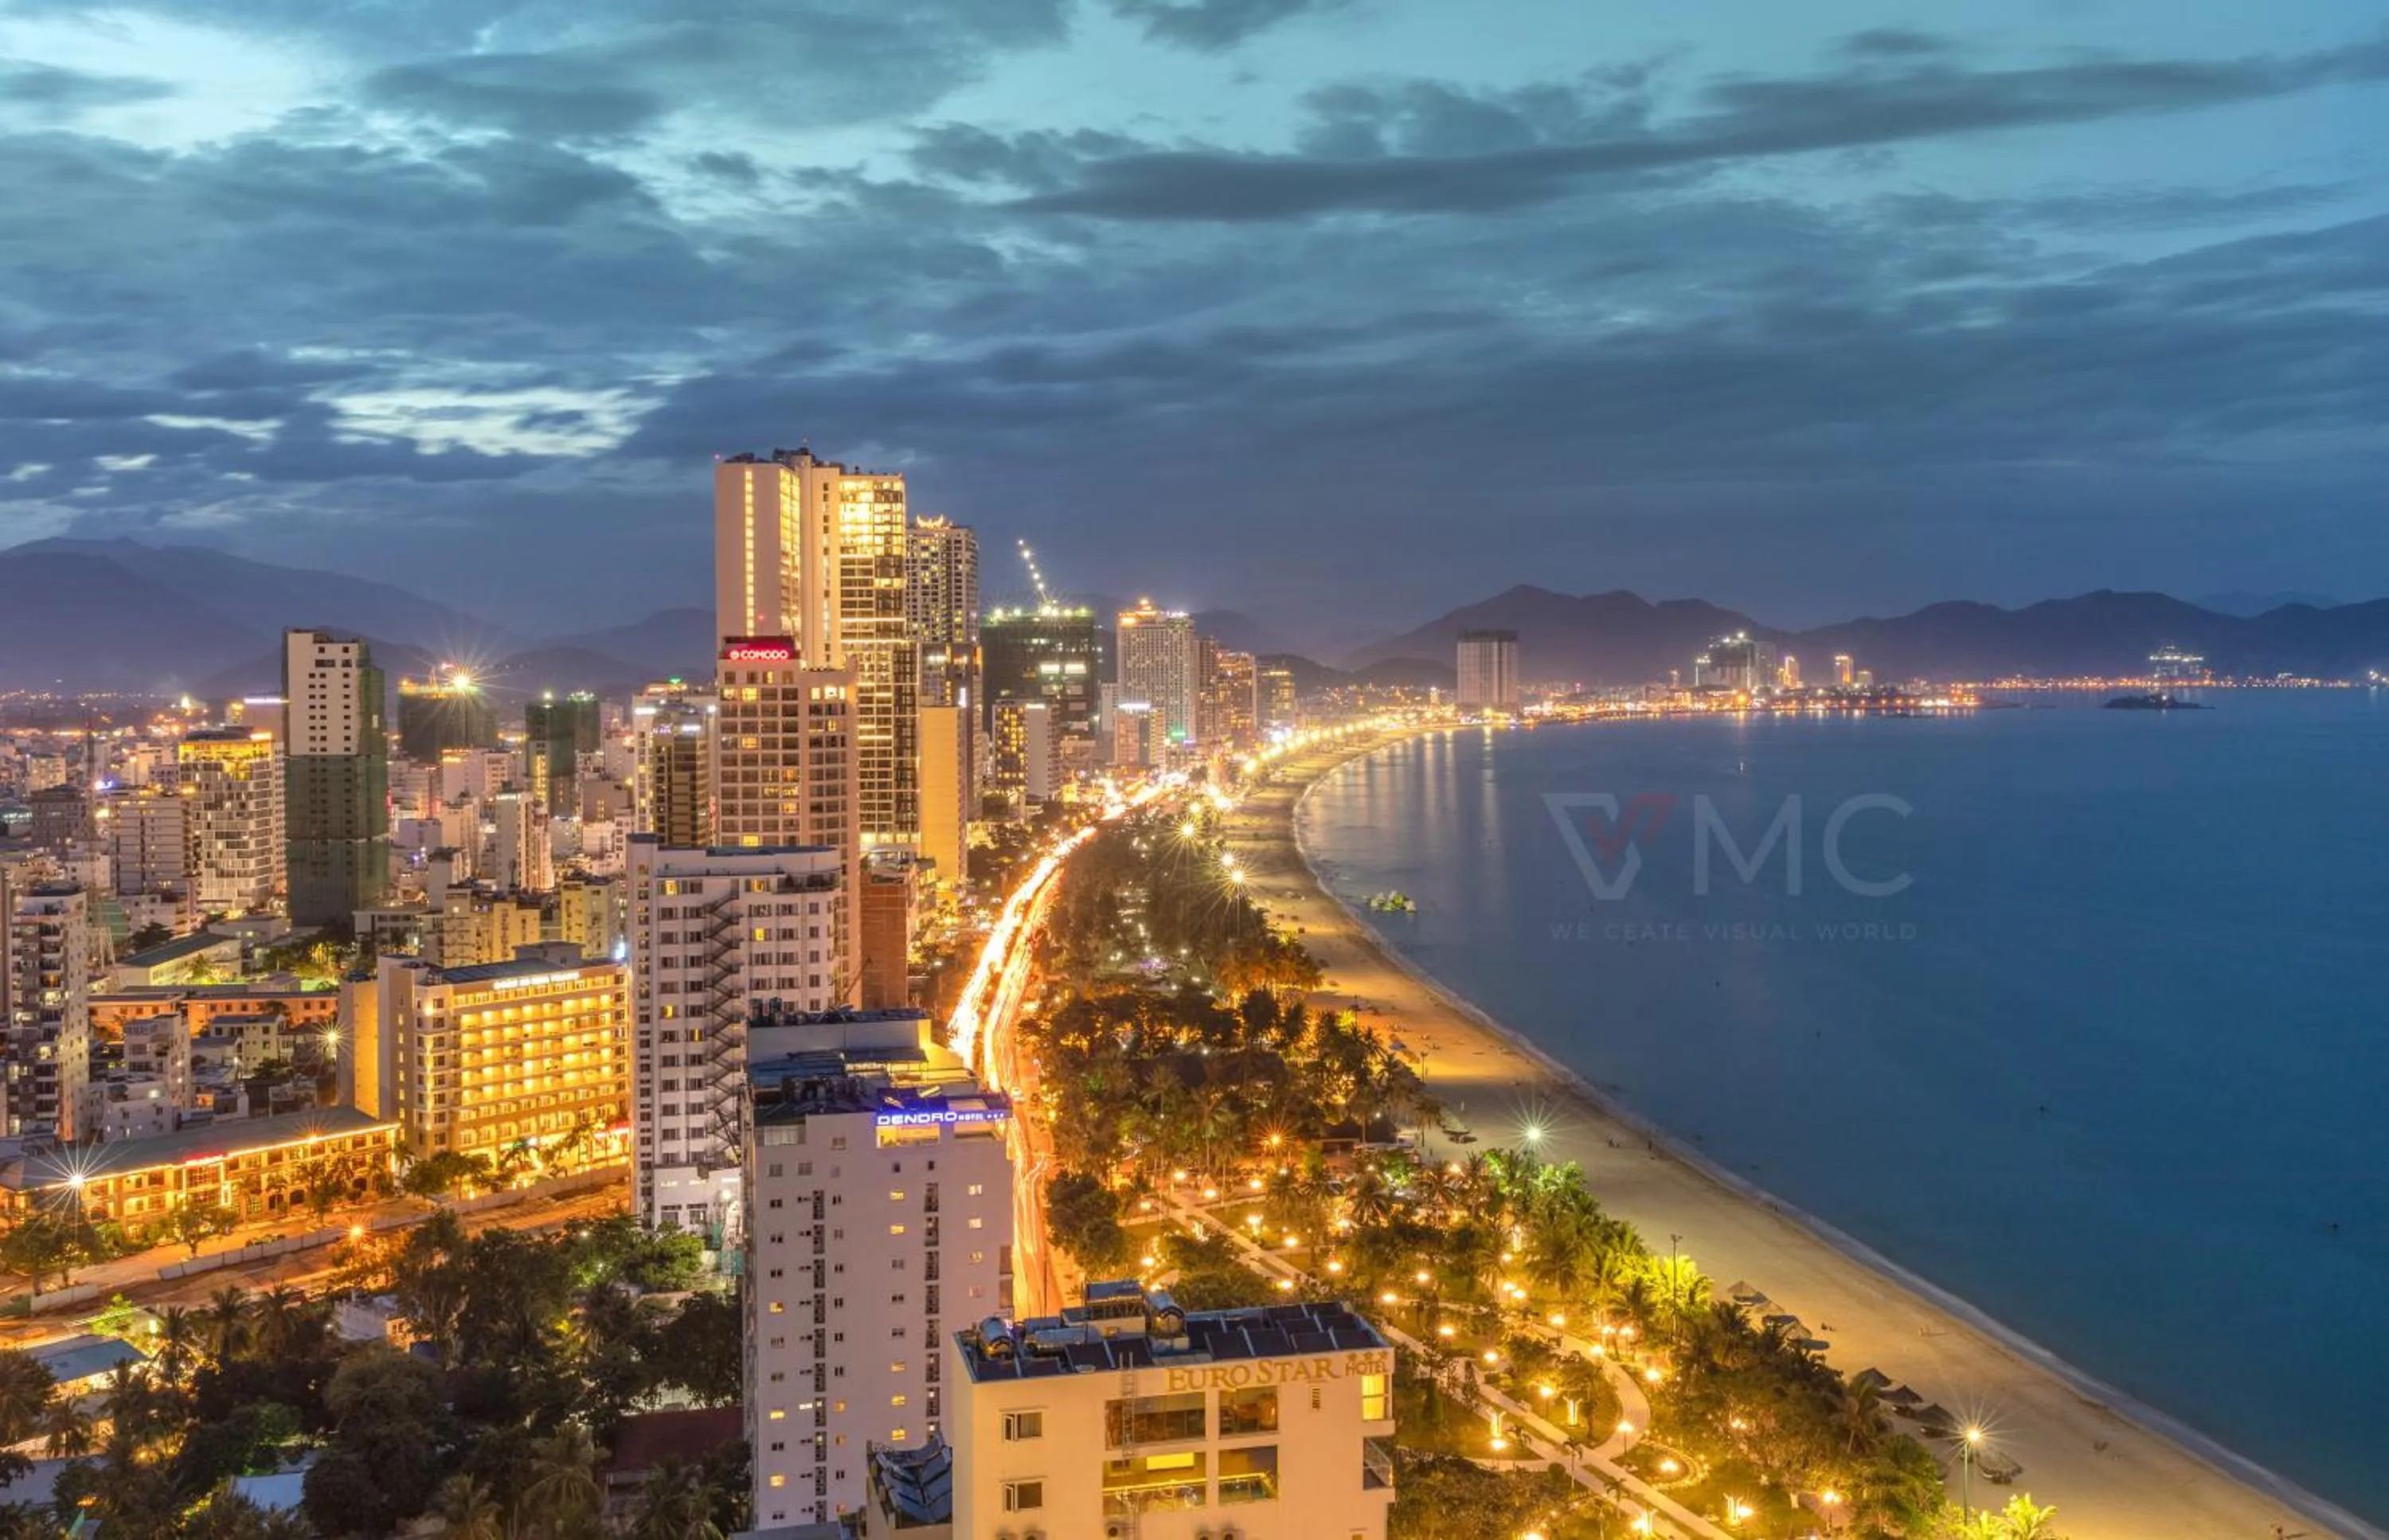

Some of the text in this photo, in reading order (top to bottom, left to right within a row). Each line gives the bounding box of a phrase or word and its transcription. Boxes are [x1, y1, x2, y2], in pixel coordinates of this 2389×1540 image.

[741, 650, 788, 659] COMODO
[878, 1112, 957, 1125] DENDRO
[1167, 1358, 1389, 1392] EURO STAR HOTEL
